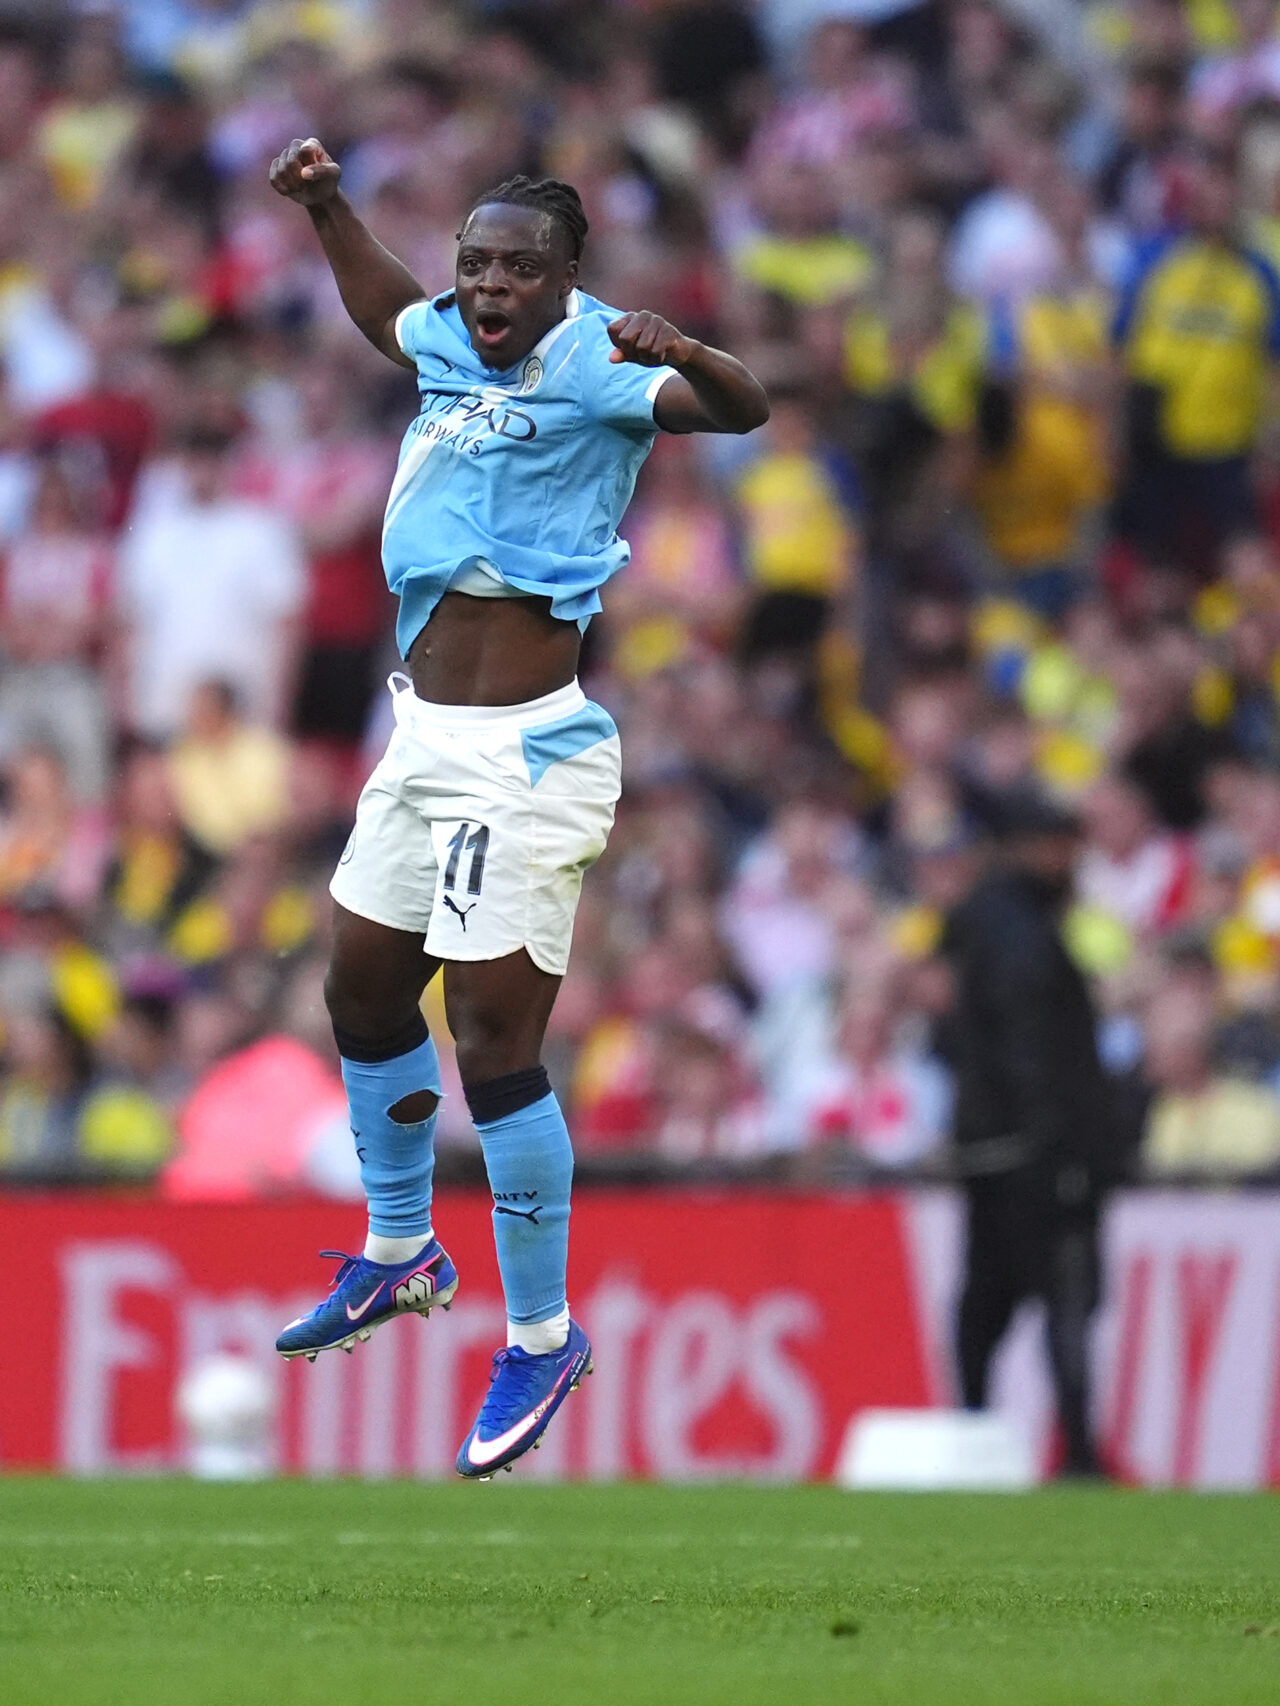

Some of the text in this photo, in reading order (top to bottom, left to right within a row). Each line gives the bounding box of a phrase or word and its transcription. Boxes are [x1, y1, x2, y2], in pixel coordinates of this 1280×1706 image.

[410, 418, 484, 456] AIRWAYS
[443, 823, 490, 896] 11
[58, 1238, 826, 1480] Emirtes
